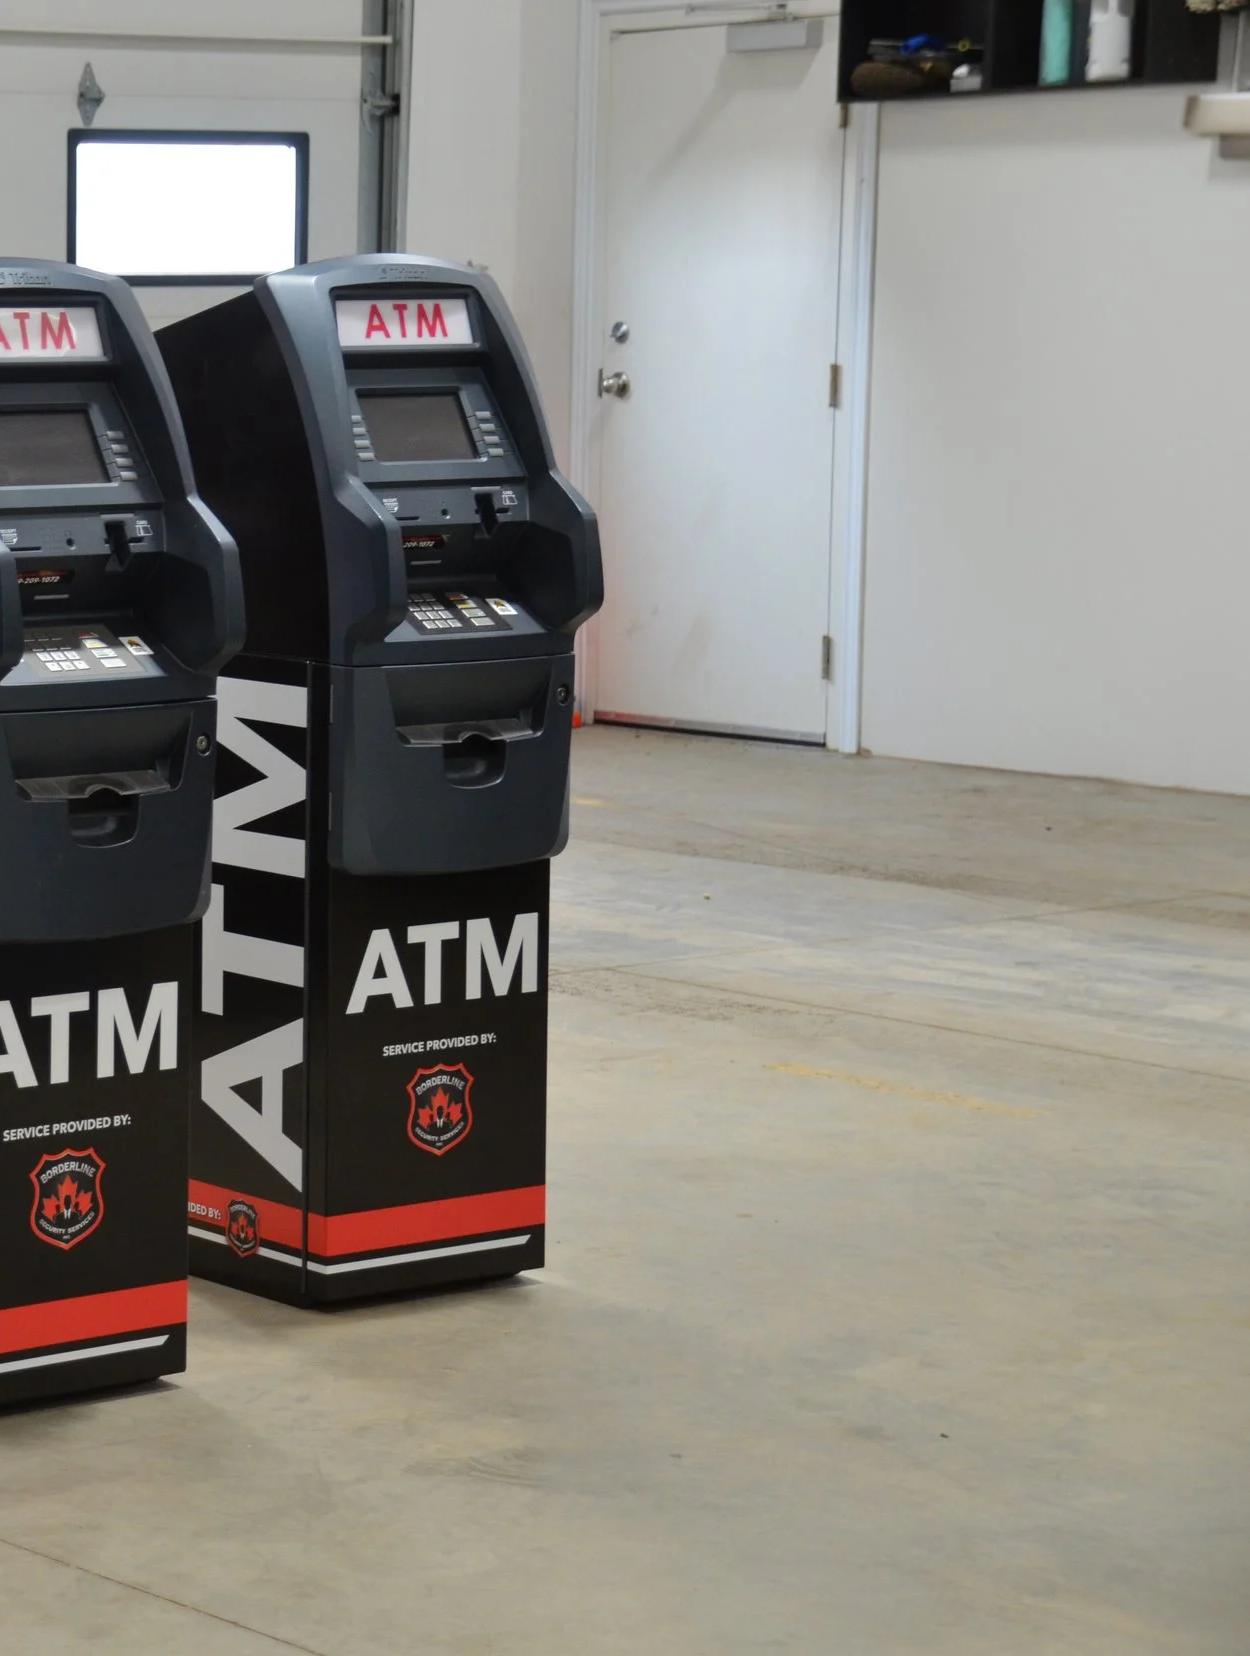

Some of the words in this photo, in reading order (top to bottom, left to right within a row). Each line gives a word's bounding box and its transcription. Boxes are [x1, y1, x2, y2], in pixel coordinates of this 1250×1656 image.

[365, 303, 448, 339] ATM
[201, 676, 308, 1193] ATM
[345, 912, 539, 1015] ATM
[382, 1041, 424, 1057] SERVICE
[426, 1034, 479, 1051] PROVIDED
[480, 1032, 497, 1044] BY:
[415, 1075, 466, 1096] BORDERLINE
[2, 1124, 50, 1143] SERVICE
[52, 1116, 112, 1136] PROVIDED
[113, 1113, 132, 1127] BY:
[40, 1161, 96, 1184] BORDERLINE
